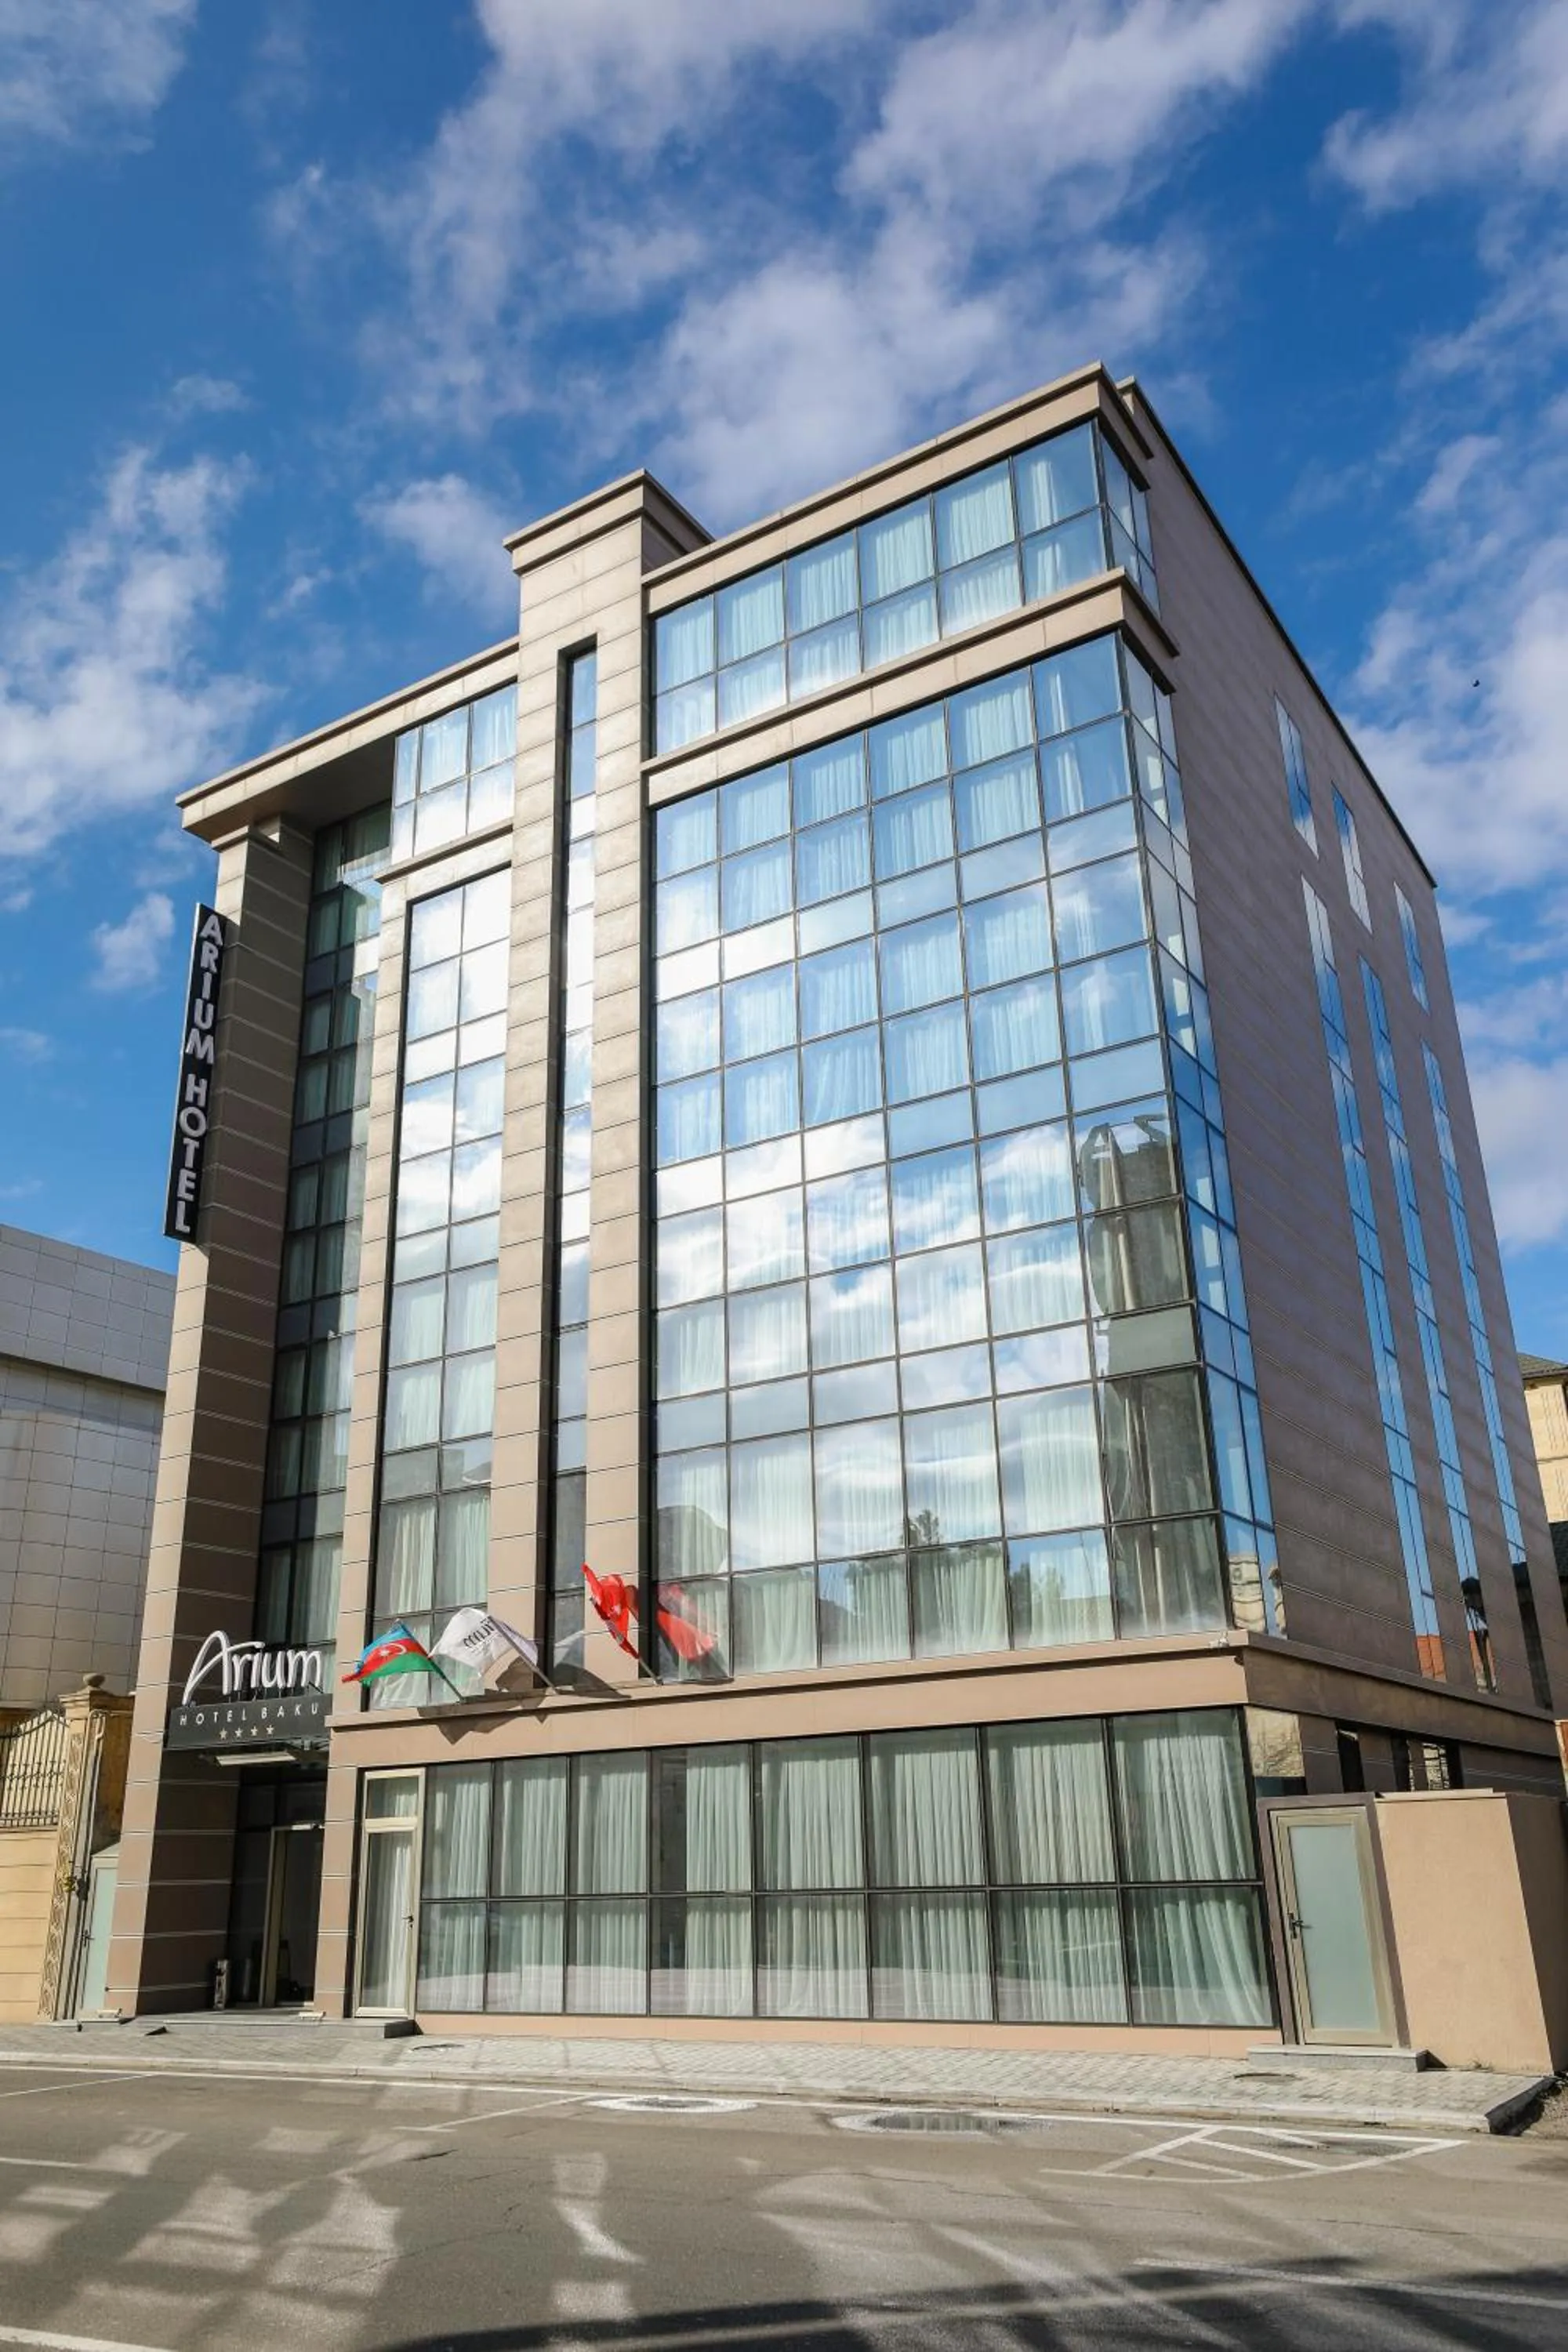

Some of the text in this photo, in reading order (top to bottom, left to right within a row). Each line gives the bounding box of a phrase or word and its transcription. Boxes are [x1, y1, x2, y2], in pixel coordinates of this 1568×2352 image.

[175, 913, 223, 1233] ARIUM HOTEL
[181, 1630, 321, 1707] Arium
[180, 1702, 320, 1726] HOTEL BAKU
